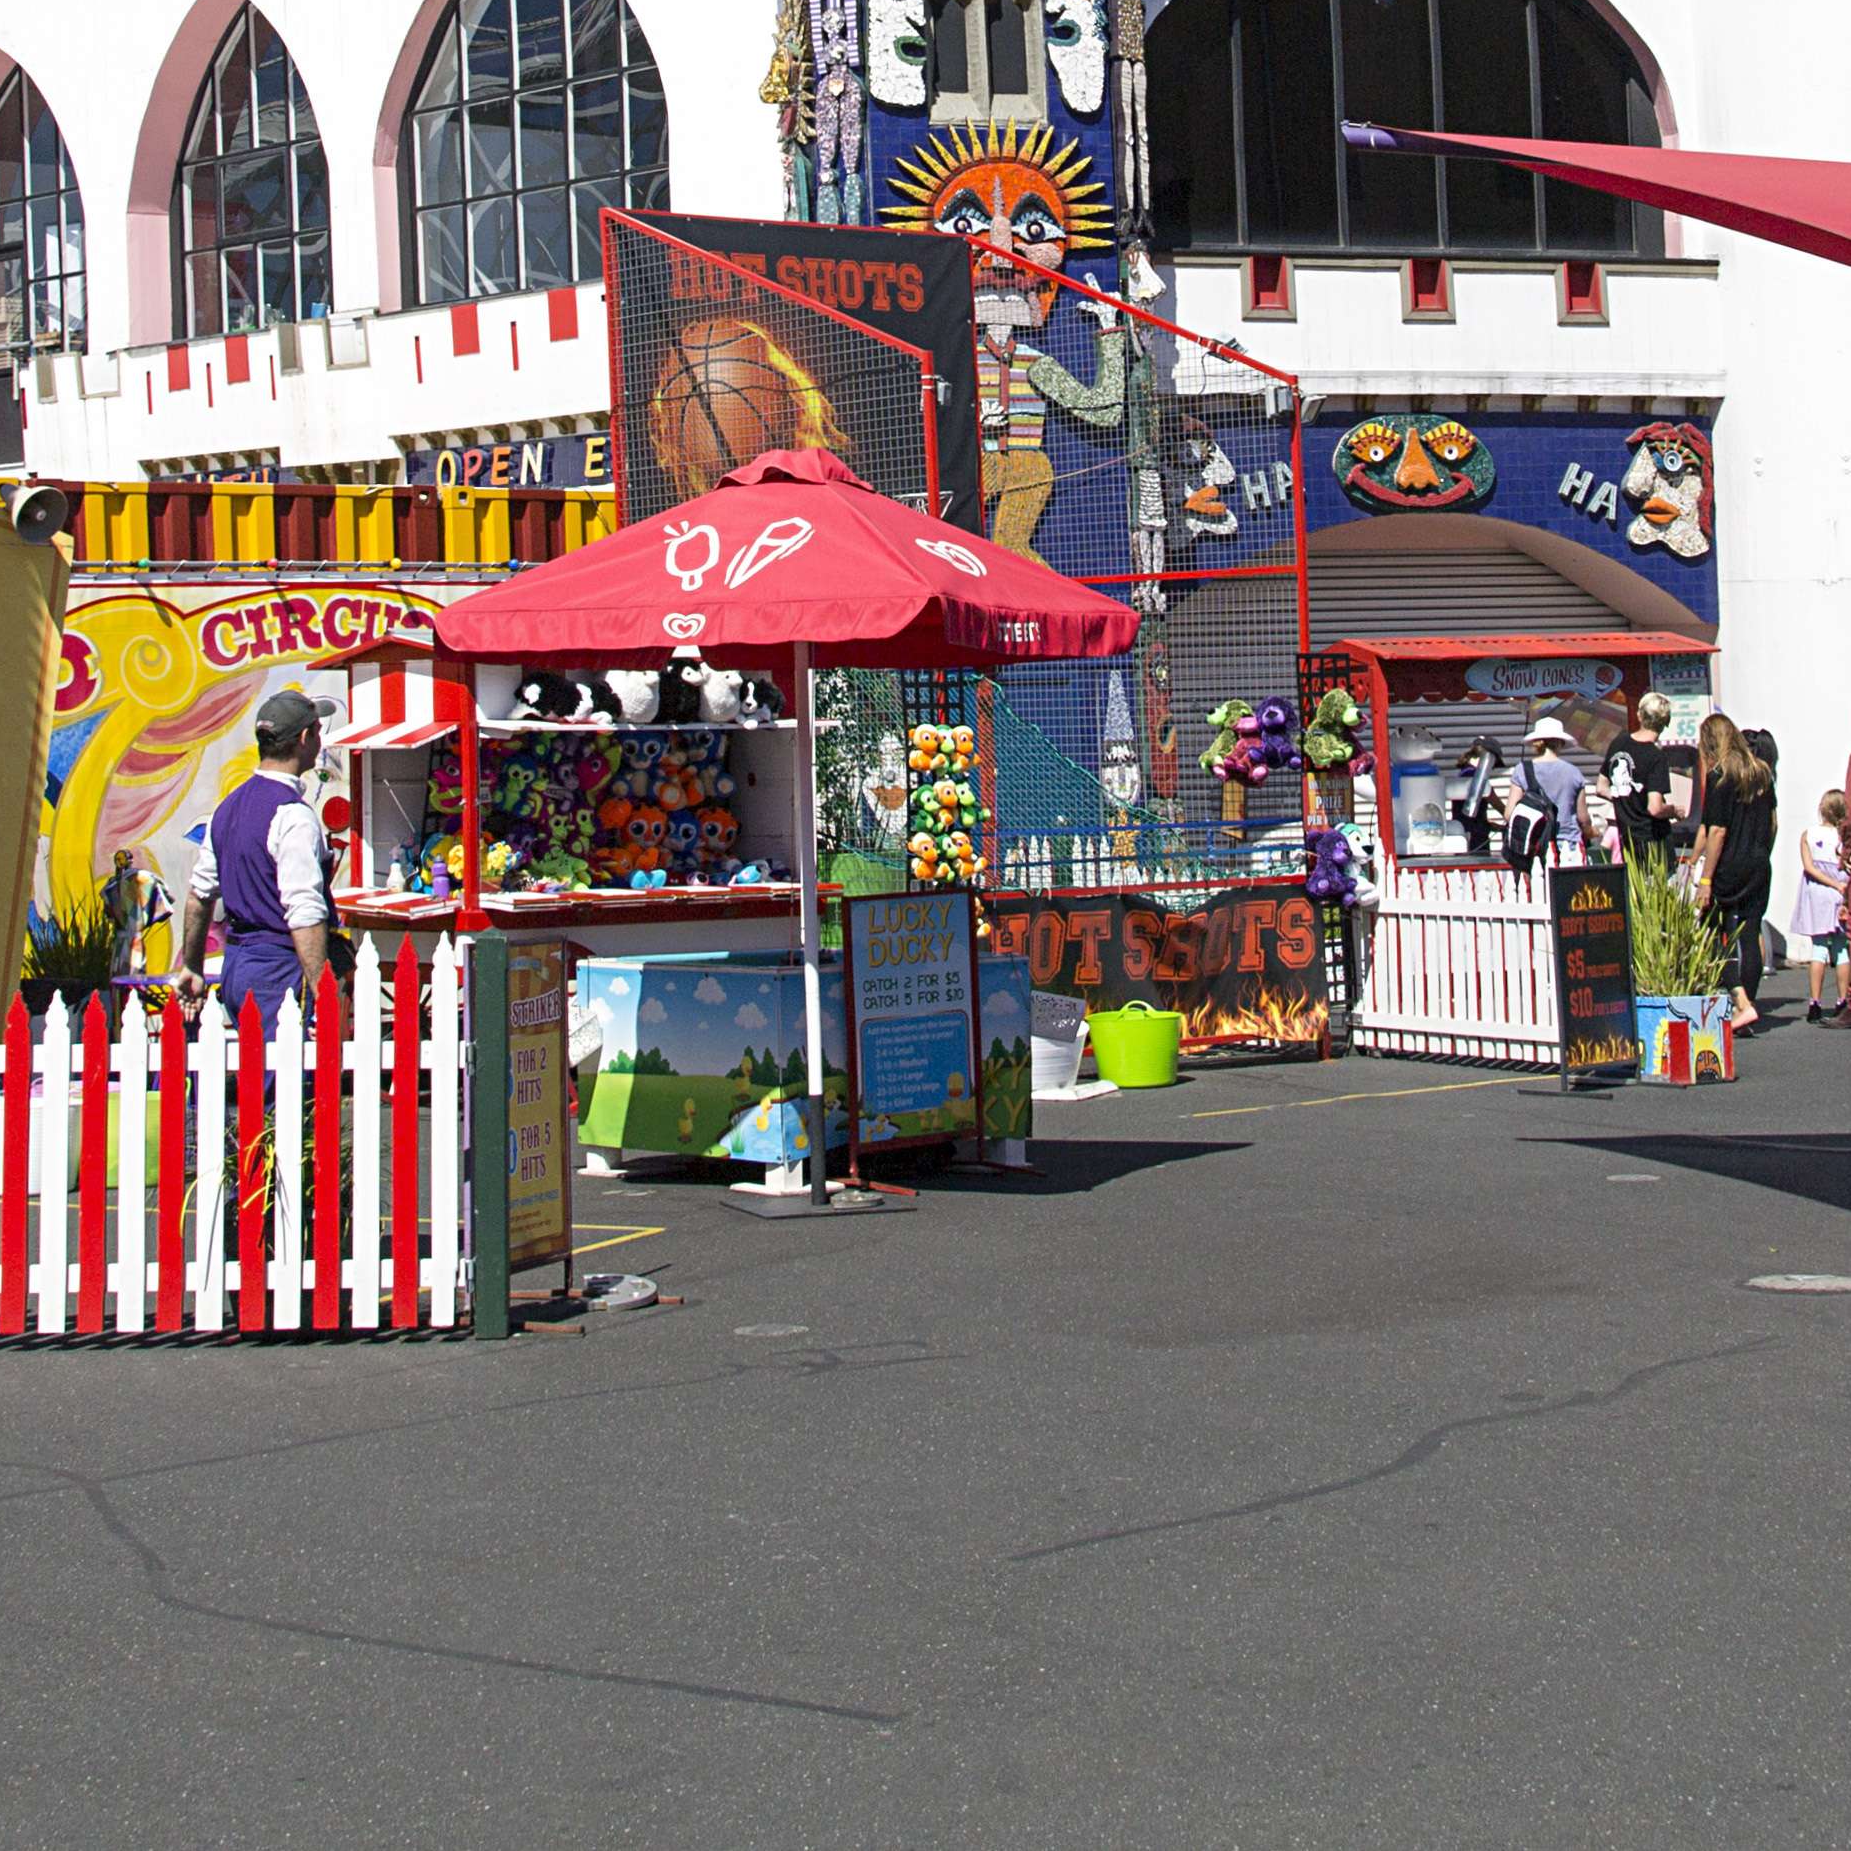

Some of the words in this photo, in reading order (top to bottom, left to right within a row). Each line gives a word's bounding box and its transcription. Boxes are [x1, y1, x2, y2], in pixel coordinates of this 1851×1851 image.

[775, 255, 925, 313] SHOTS
[436, 441, 544, 489] OPEN
[1559, 462, 1619, 522] HA
[1492, 662, 1537, 692] SNOW
[1542, 663, 1585, 688] CONES
[1676, 719, 1696, 738] $5
[868, 899, 954, 934] LUCKY
[1560, 916, 1586, 938] HOT
[1588, 913, 1626, 935] SHOTS
[868, 932, 954, 968] DUCKY
[990, 909, 1113, 986] HOT
[1122, 897, 1317, 981] SHOTS
[1566, 948, 1586, 980] $5
[863, 977, 898, 993] CATCH
[904, 976, 912, 989] 2
[917, 973, 939, 988] FOR
[945, 971, 960, 985] $5
[511, 987, 563, 1028] STRIKER
[863, 994, 899, 1010] CATCH
[904, 993, 912, 1006] 5
[917, 991, 940, 1005] FOR
[945, 988, 964, 1002] $10
[1569, 986, 1594, 1018] $10
[517, 1048, 536, 1075] FOR
[540, 1046, 547, 1071] 2
[517, 1077, 542, 1106] HITS
[520, 1124, 540, 1152] FOR
[544, 1122, 551, 1146] 5
[521, 1153, 547, 1182] HITS
